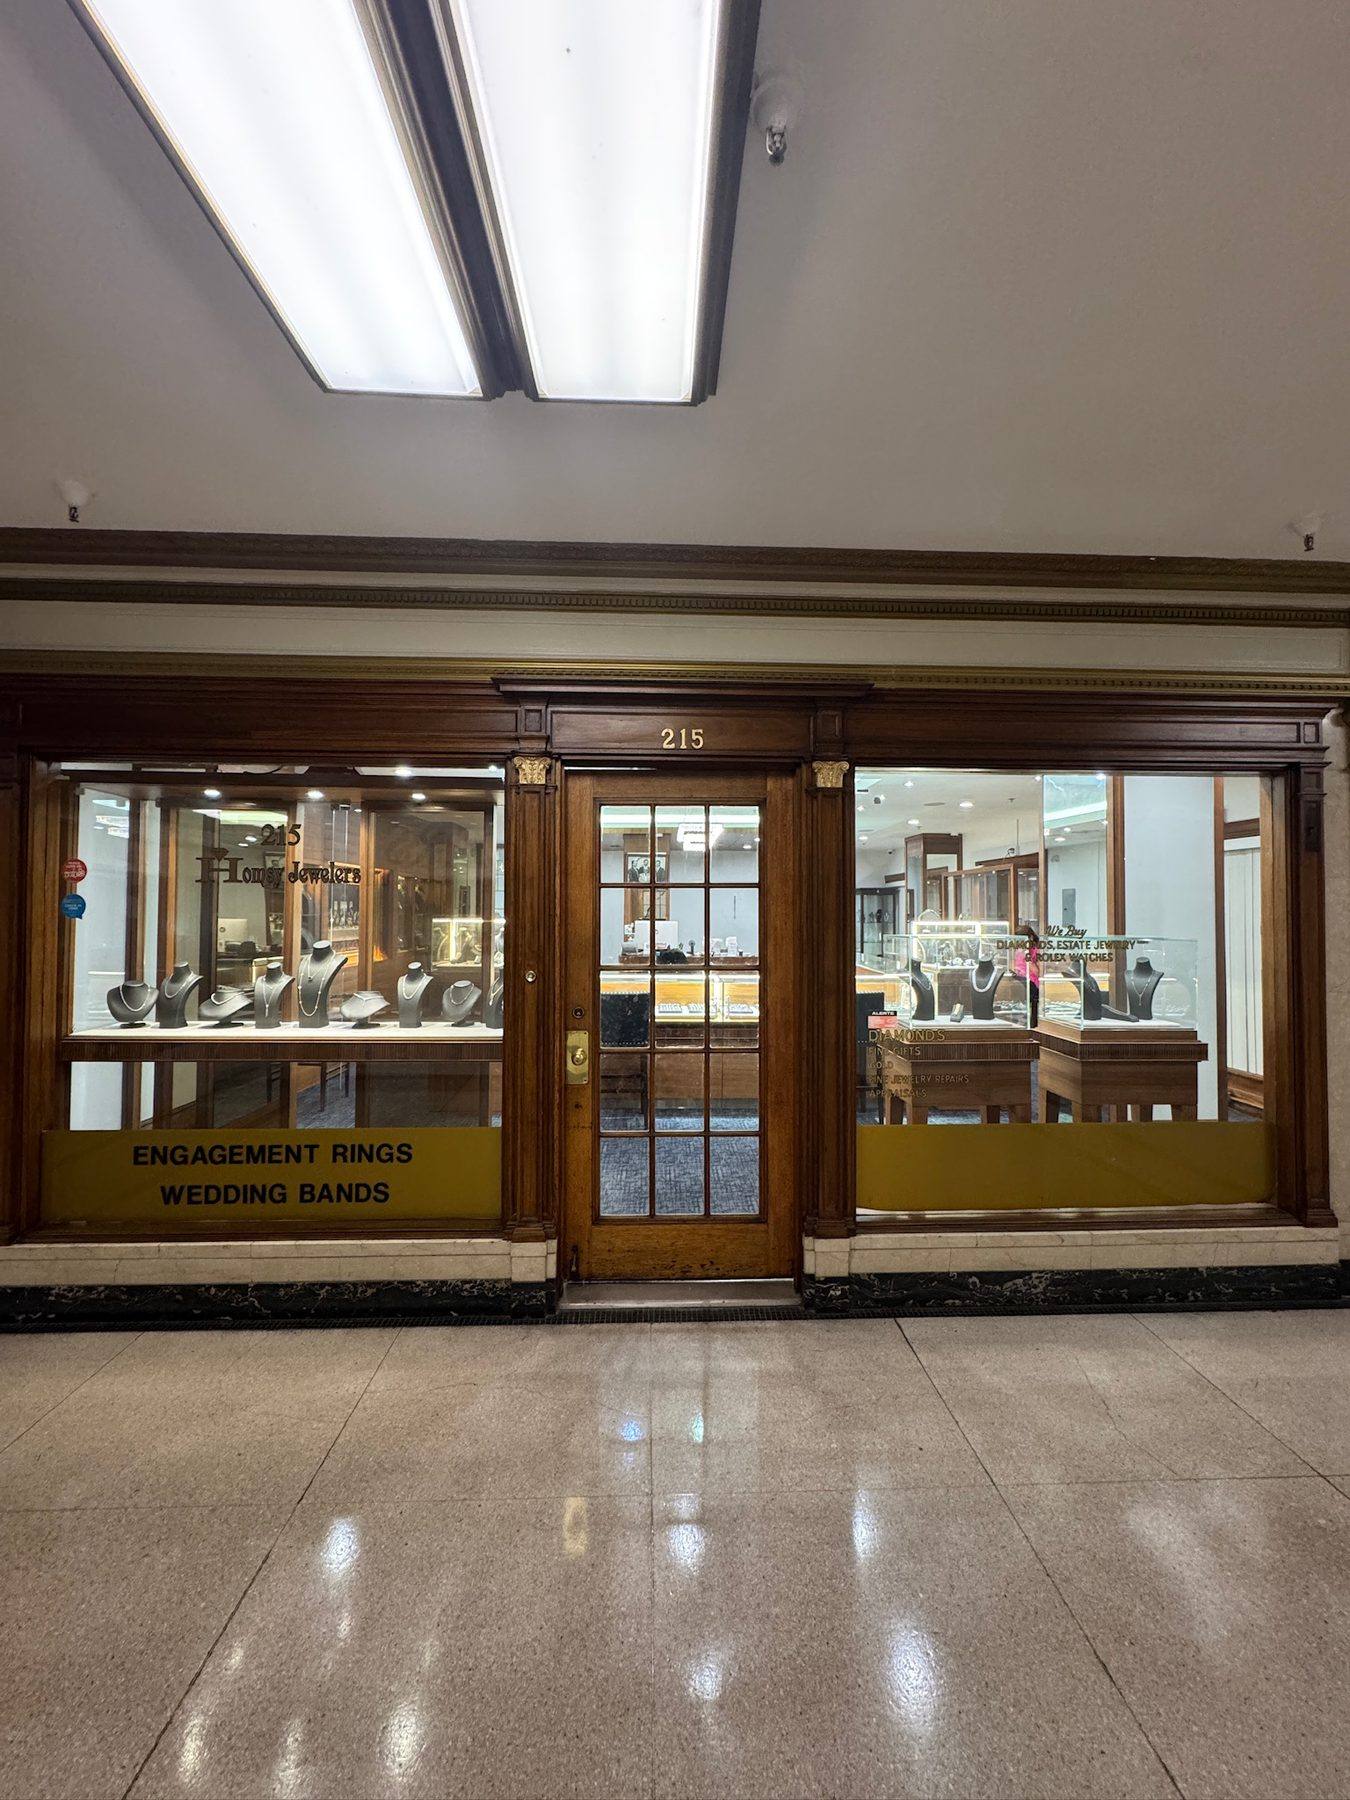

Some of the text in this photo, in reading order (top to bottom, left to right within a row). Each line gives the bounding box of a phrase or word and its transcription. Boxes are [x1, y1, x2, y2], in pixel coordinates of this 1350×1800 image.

[661, 728, 704, 749] 215
[261, 824, 301, 846] 215
[195, 853, 361, 887] Homsy Jewelers
[1044, 925, 1088, 939] We Buy
[996, 940, 1136, 951] DIAMODS, ESTATE JEWRY
[1034, 952, 1066, 962] ROLEX
[1069, 952, 1113, 962] WATCHES
[868, 1028, 945, 1041] DIAMONDS
[868, 1046, 920, 1056] FIN GIFTS
[868, 1074, 969, 1084] INE JEWELRY REPAIRS
[869, 1089, 927, 1098] APPRAISALS
[132, 1143, 413, 1165] ENGAGEMENT RINGS
[160, 1182, 390, 1205] WEDDING BANDS
